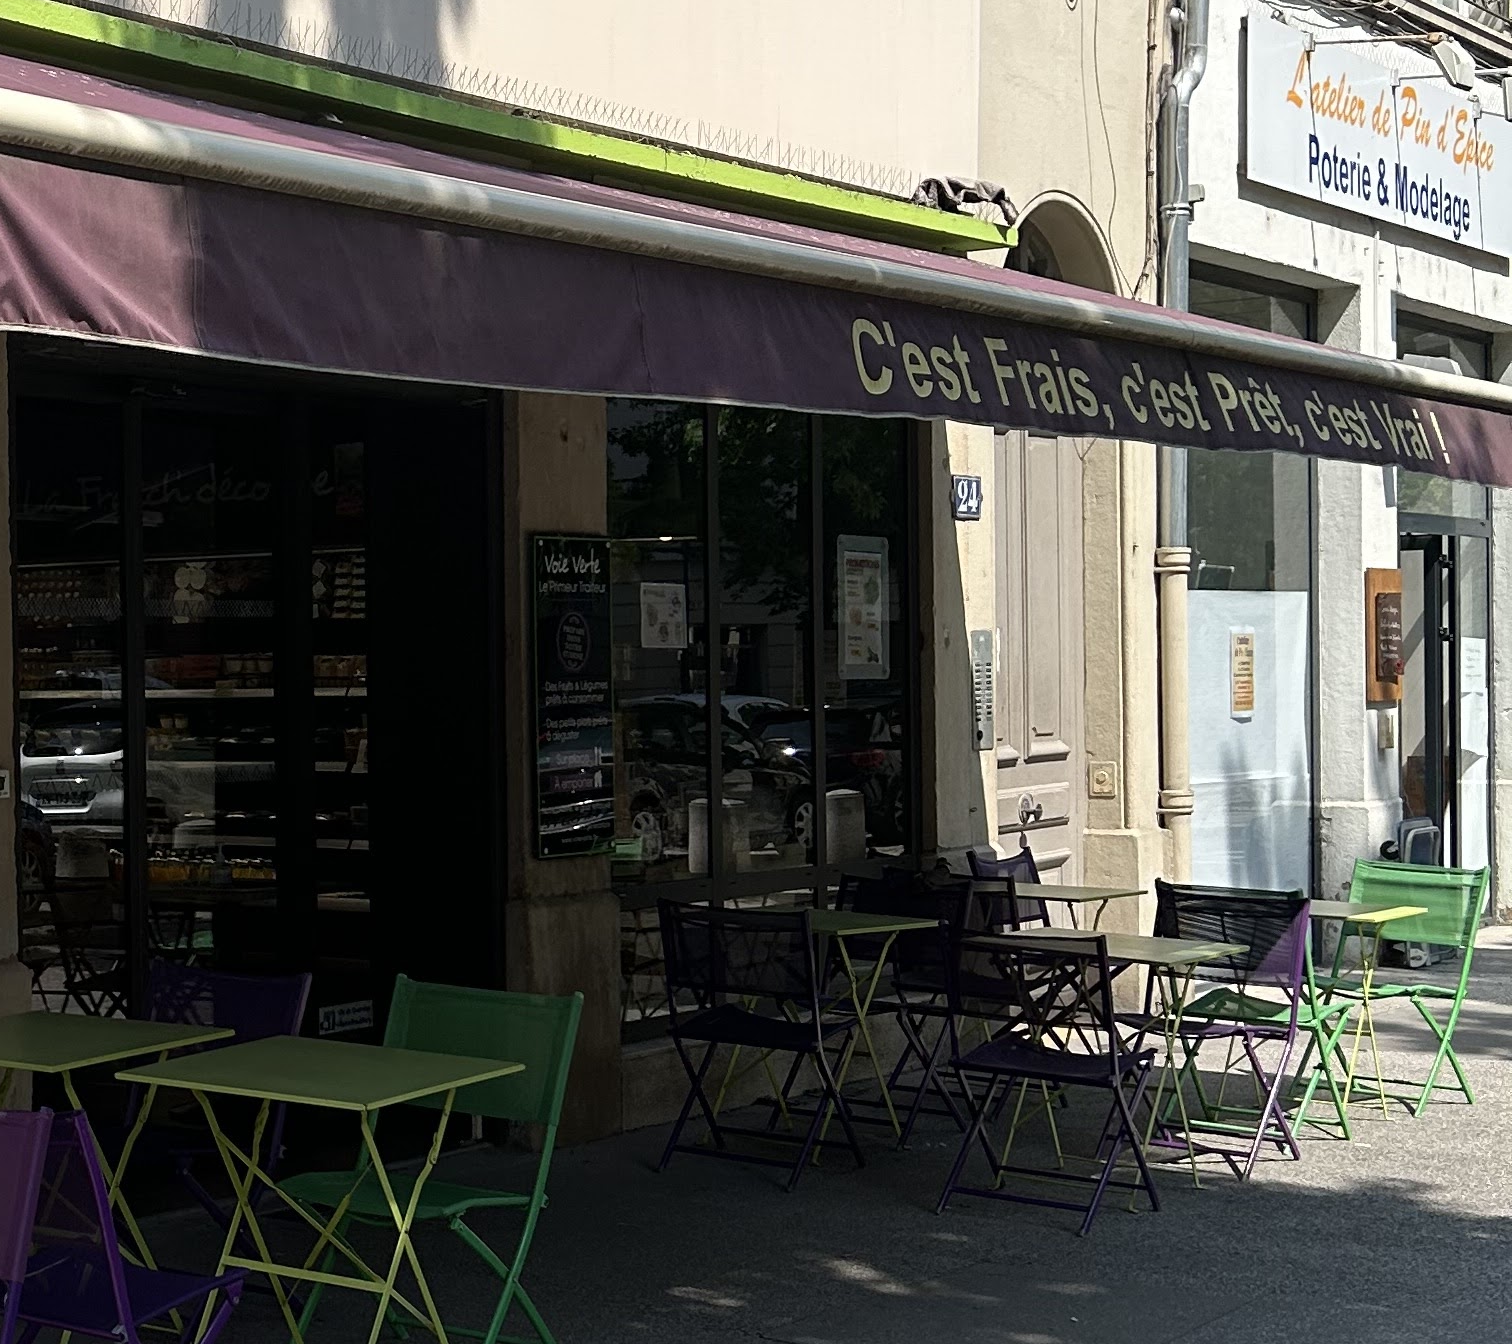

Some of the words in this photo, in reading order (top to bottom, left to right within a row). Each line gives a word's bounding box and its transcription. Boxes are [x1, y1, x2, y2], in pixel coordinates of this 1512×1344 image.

[1286, 50, 1367, 129] Latelier
[1372, 89, 1391, 137] de
[1400, 86, 1432, 147] Pin
[1308, 133, 1371, 201] Poterie
[1377, 157, 1390, 206] &
[1395, 162, 1470, 240] Modelage
[851, 317, 983, 405] C'est
[983, 336, 1115, 431] Frais,
[1121, 362, 1211, 432] c'est
[1207, 370, 1304, 448] Prêt,
[1304, 389, 1382, 451] c'est
[1369, 399, 1434, 462] Vrai
[957, 478, 979, 513] 24
[544, 551, 570, 575] Voie
[571, 547, 601, 575] Verte
